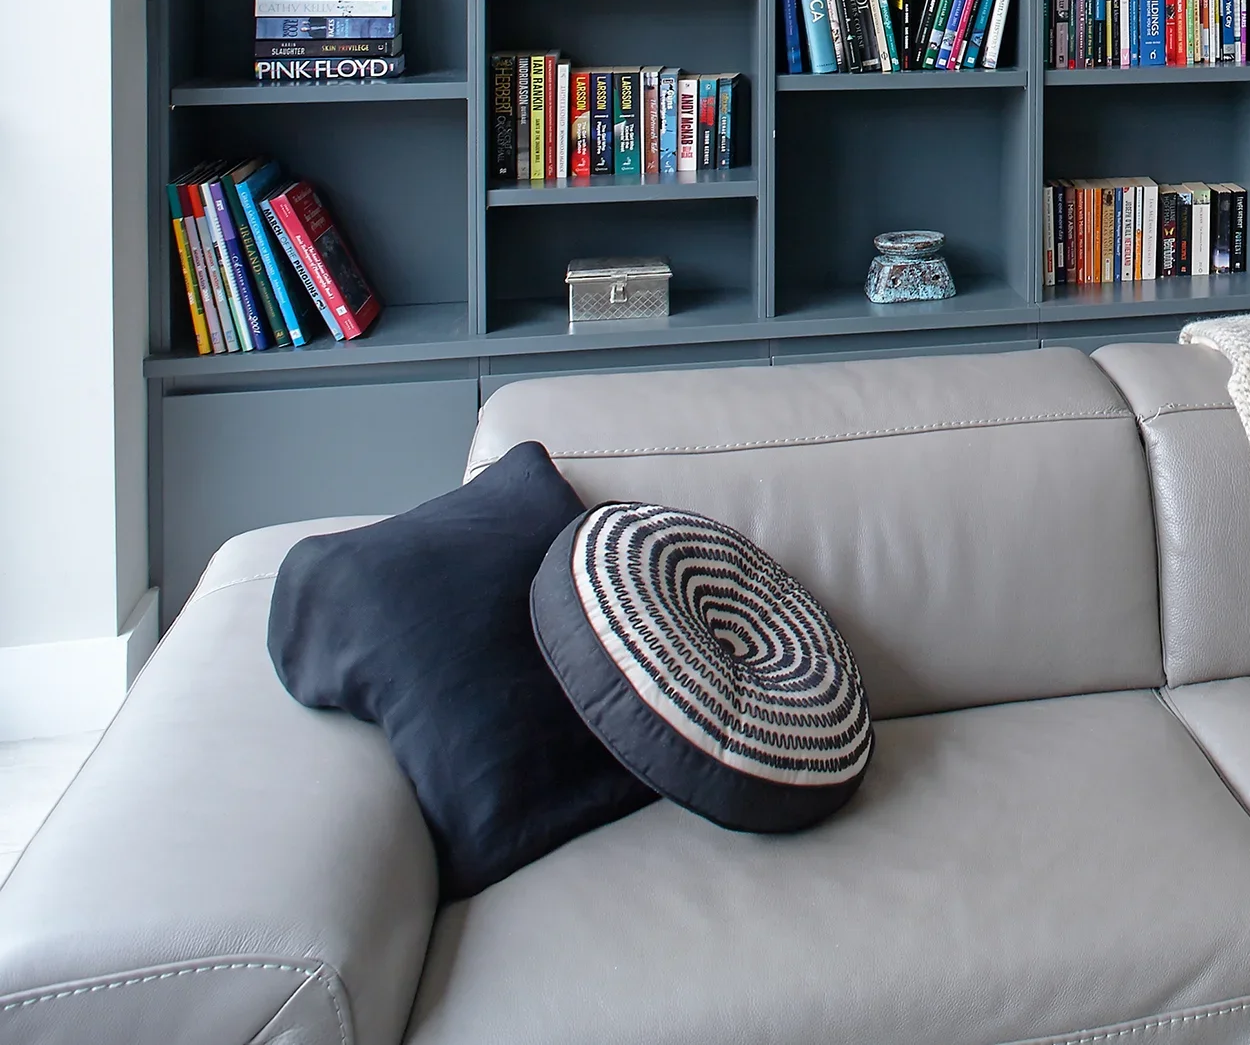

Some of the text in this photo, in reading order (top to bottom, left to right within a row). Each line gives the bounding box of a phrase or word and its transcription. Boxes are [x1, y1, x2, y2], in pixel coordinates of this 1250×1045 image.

[1224, 16, 1232, 29] City
[257, 60, 388, 79] PINK FLOYD
[576, 76, 587, 111] LARSSON
[596, 76, 607, 110] LARSSON
[622, 76, 632, 110] LARSSON
[681, 94, 694, 145] ANDY McNAB
[240, 226, 263, 274] IRELAND
[263, 208, 282, 236] MARCH
[283, 247, 298, 259] THE
[293, 260, 319, 298] PENGUINS
